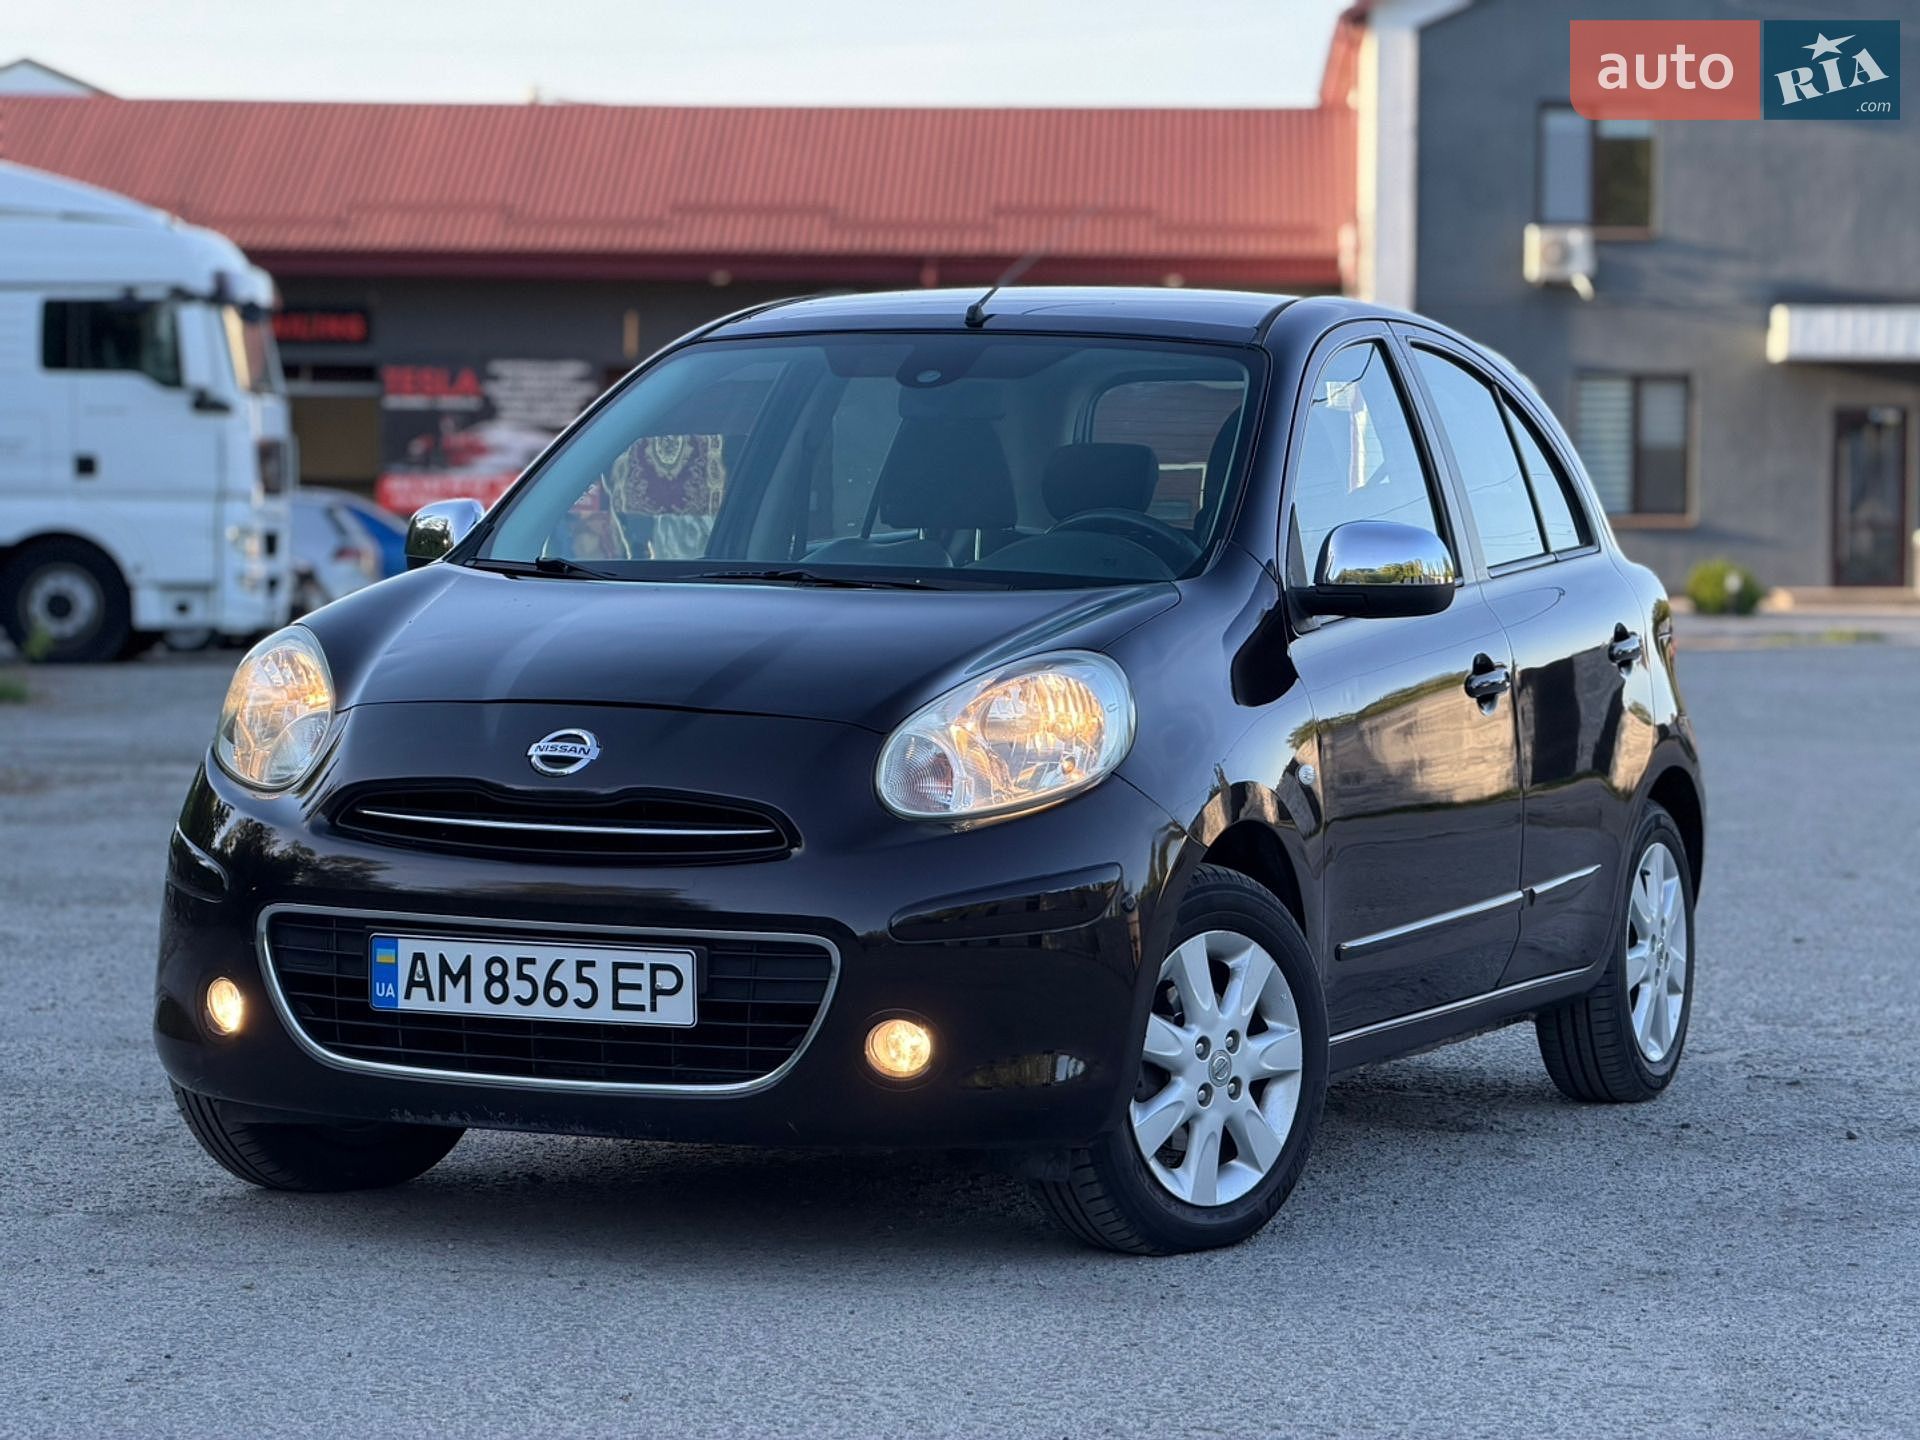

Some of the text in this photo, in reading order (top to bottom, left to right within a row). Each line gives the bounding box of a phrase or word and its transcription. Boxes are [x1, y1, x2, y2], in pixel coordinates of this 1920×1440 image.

[534, 744, 591, 756] NISSAN
[375, 982, 396, 999] UA
[483, 955, 599, 1010] 8565
